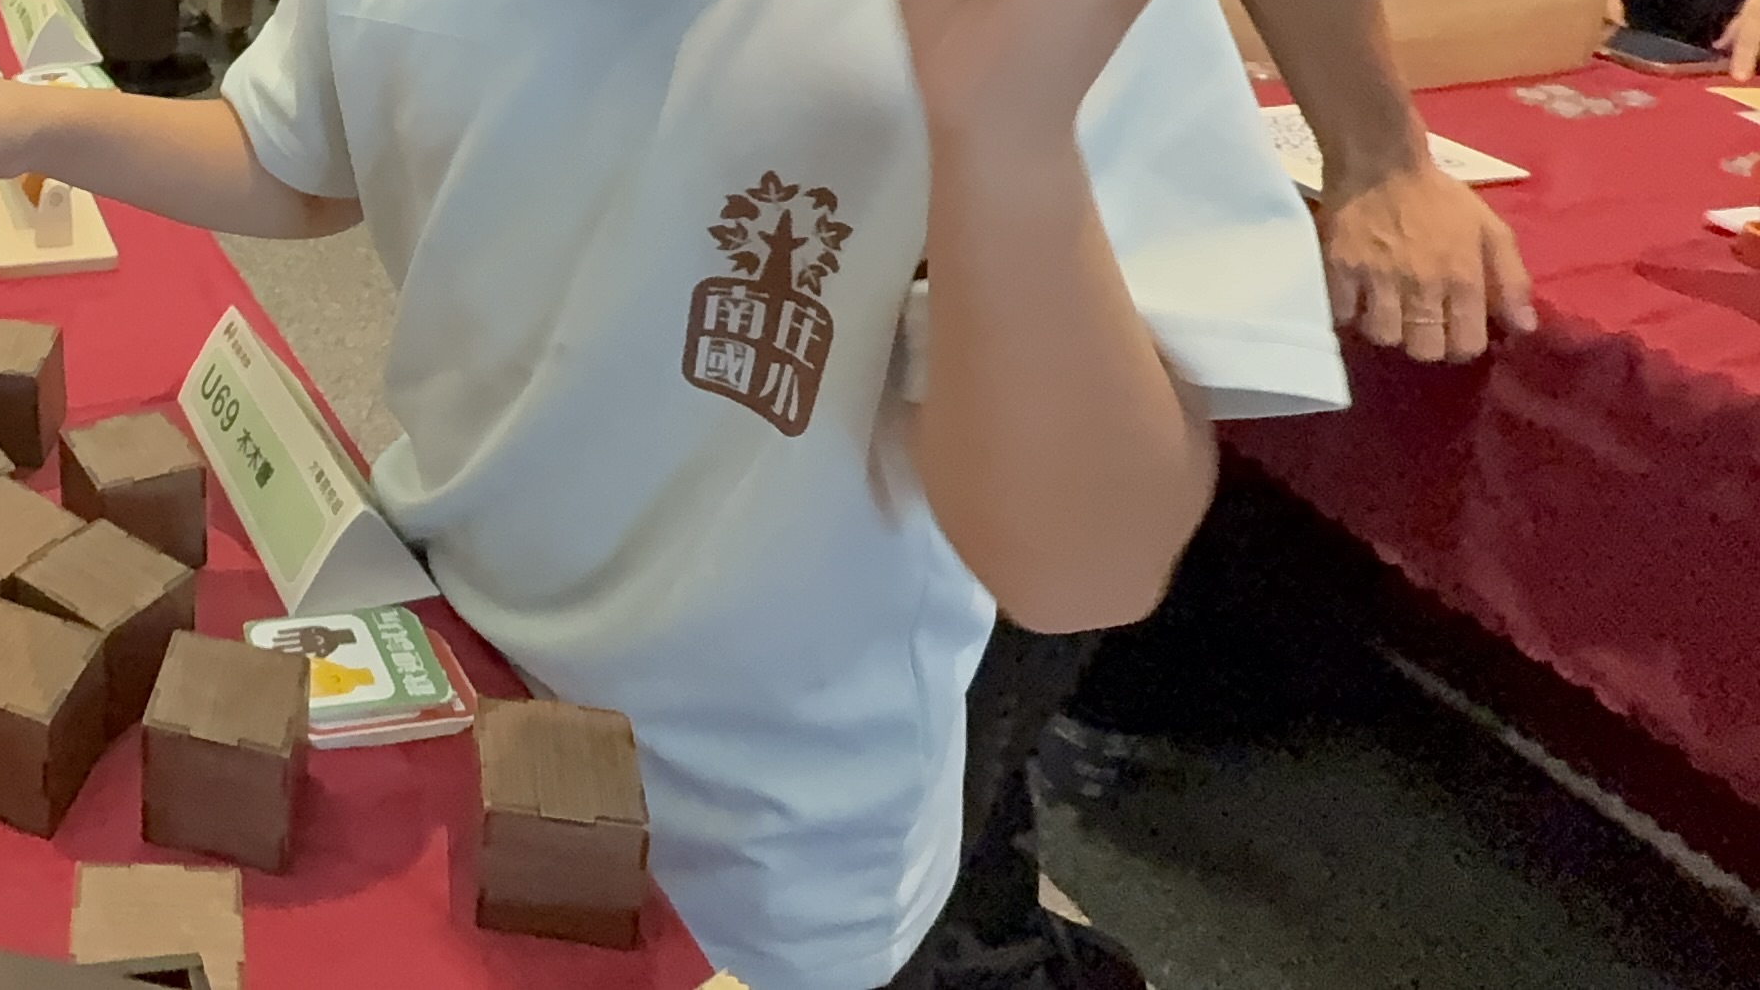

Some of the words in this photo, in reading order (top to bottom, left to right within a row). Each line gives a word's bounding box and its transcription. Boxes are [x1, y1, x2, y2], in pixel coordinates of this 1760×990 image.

[703, 285, 827, 370] 南庄
[201, 363, 240, 432] U69
[694, 335, 800, 422] 國小
